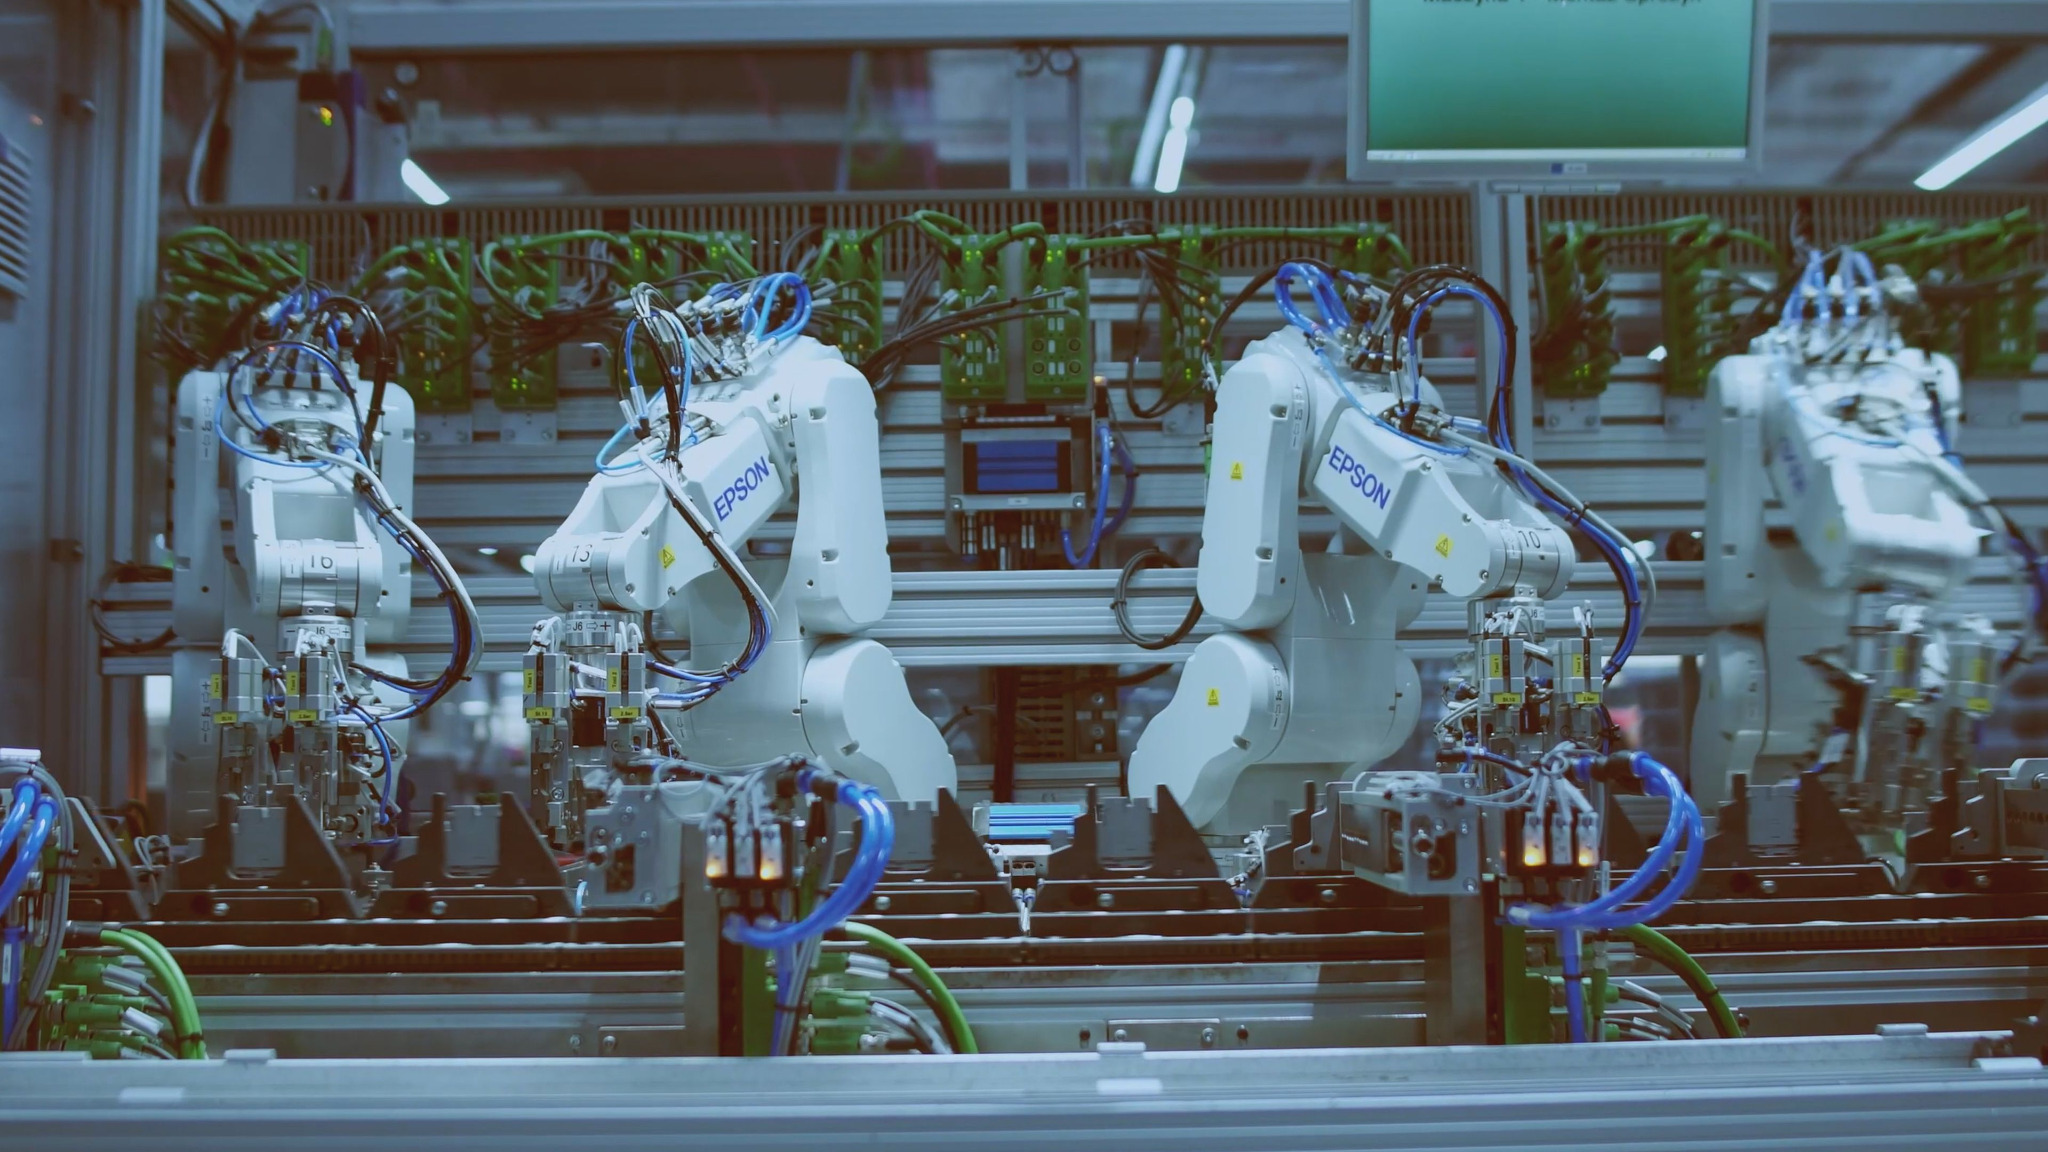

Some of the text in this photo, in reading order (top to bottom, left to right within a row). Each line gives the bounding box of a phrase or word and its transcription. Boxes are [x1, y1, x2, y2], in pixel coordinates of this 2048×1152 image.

[1328, 445, 1391, 510] EPSON
[713, 456, 770, 522] EPSON
[1518, 530, 1541, 549] 10
[572, 544, 593, 563] 13
[572, 621, 583, 631] J6
